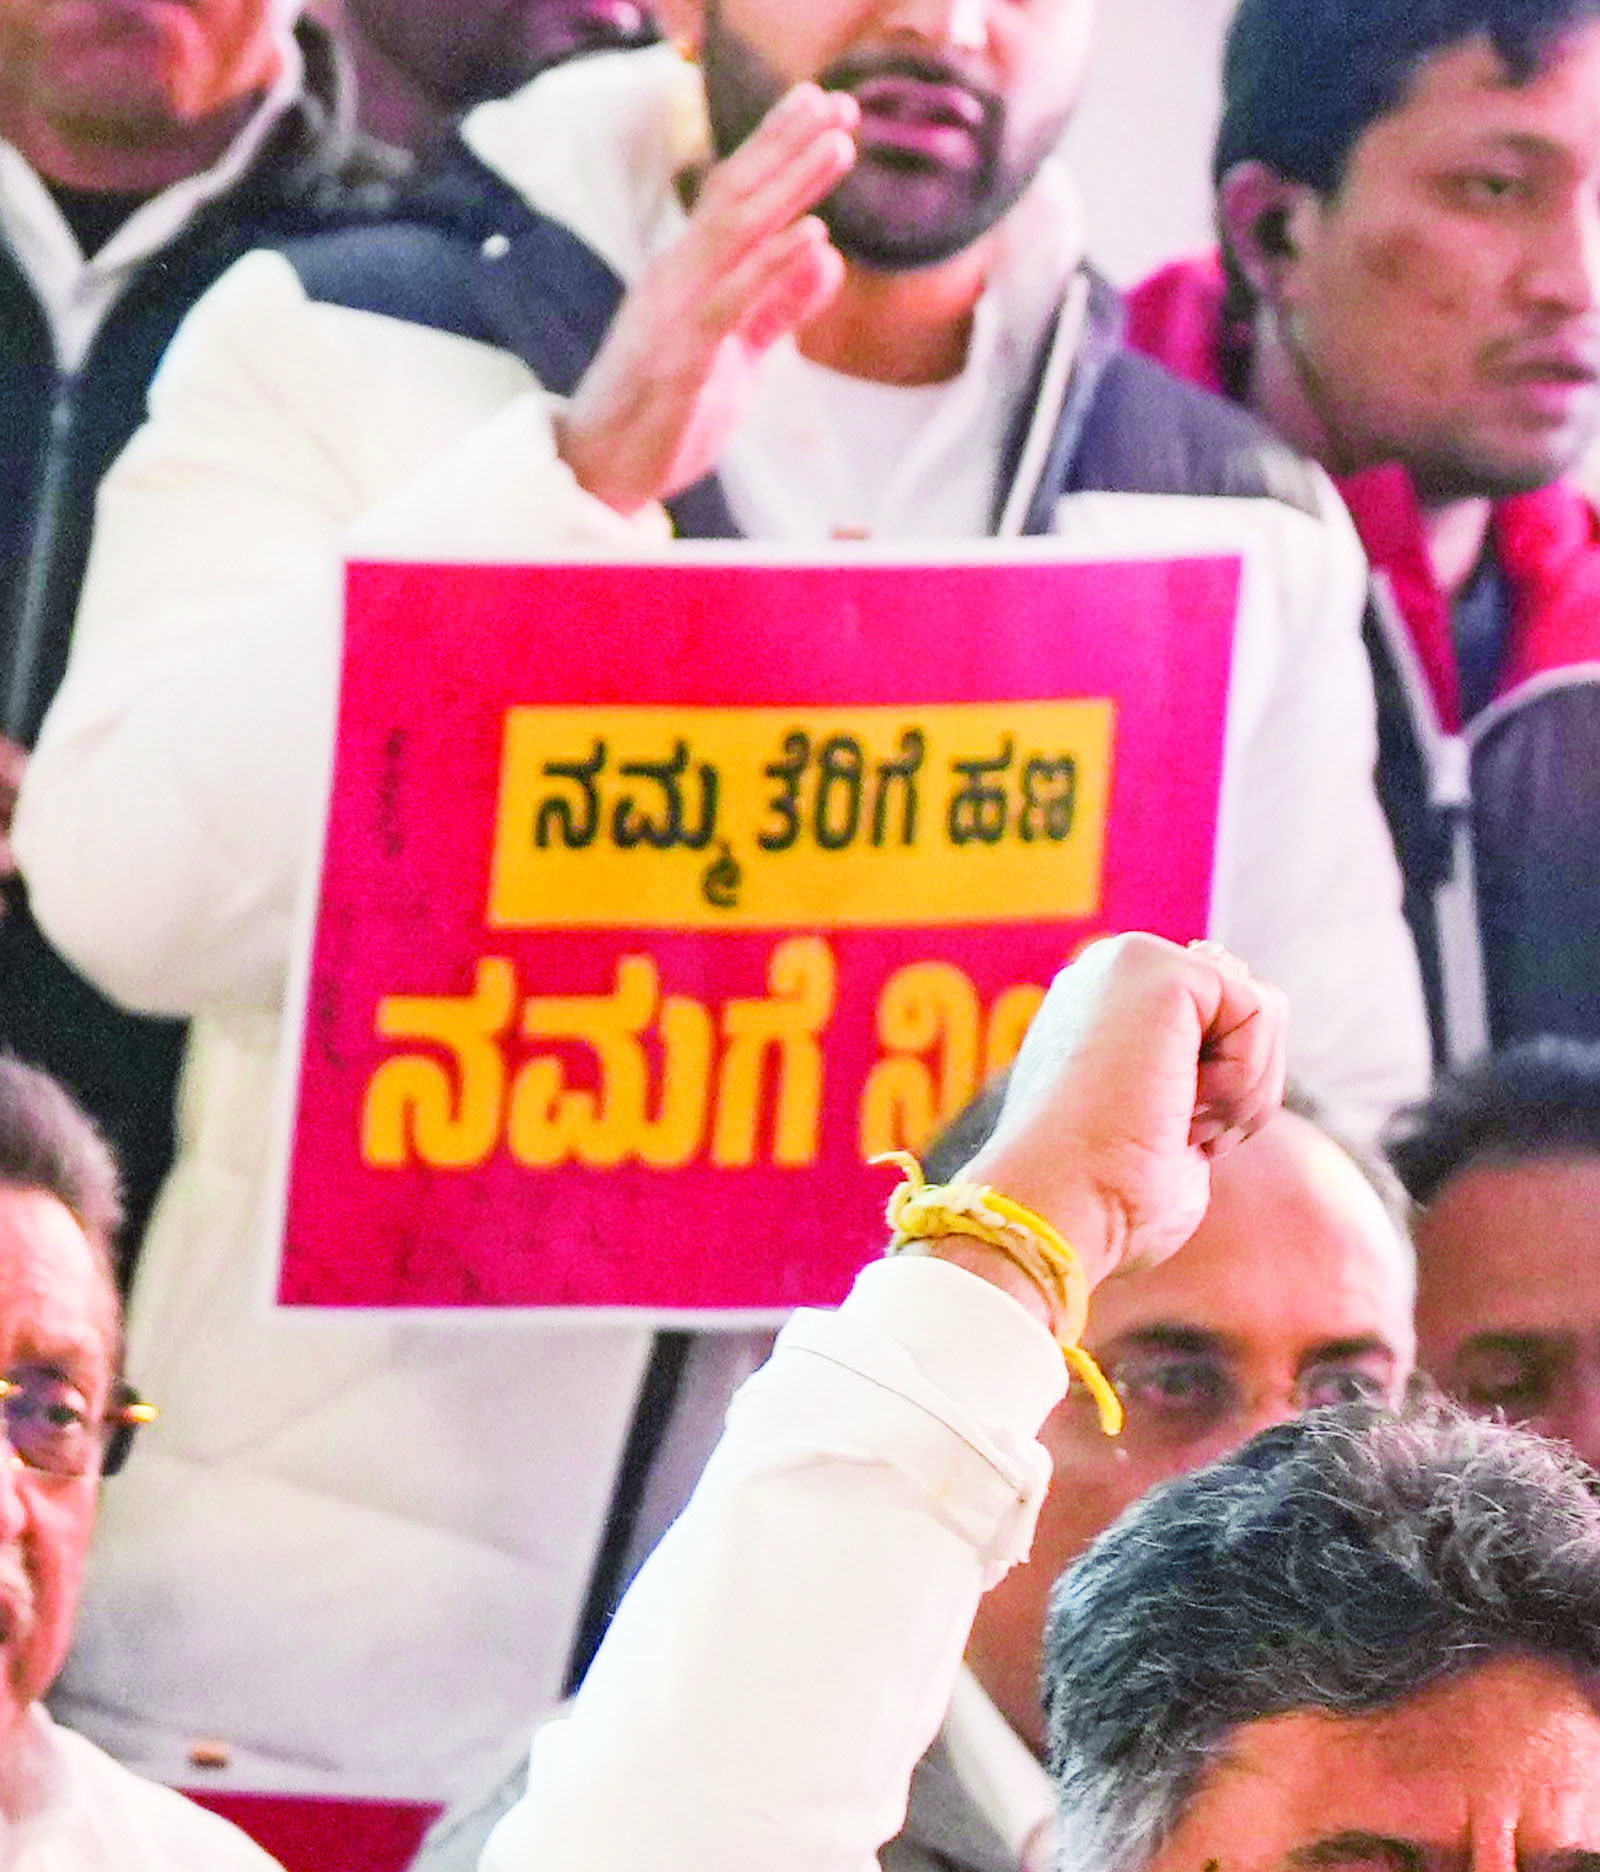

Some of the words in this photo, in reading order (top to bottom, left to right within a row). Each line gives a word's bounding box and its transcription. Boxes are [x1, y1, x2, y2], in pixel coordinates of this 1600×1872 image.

[532, 738, 744, 907] ನಮ್ಮ
[757, 725, 925, 852] ತೆರಿಗೆ
[946, 733, 1079, 846] ಹಣ
[360, 936, 837, 1169] ನಮಗೆ
